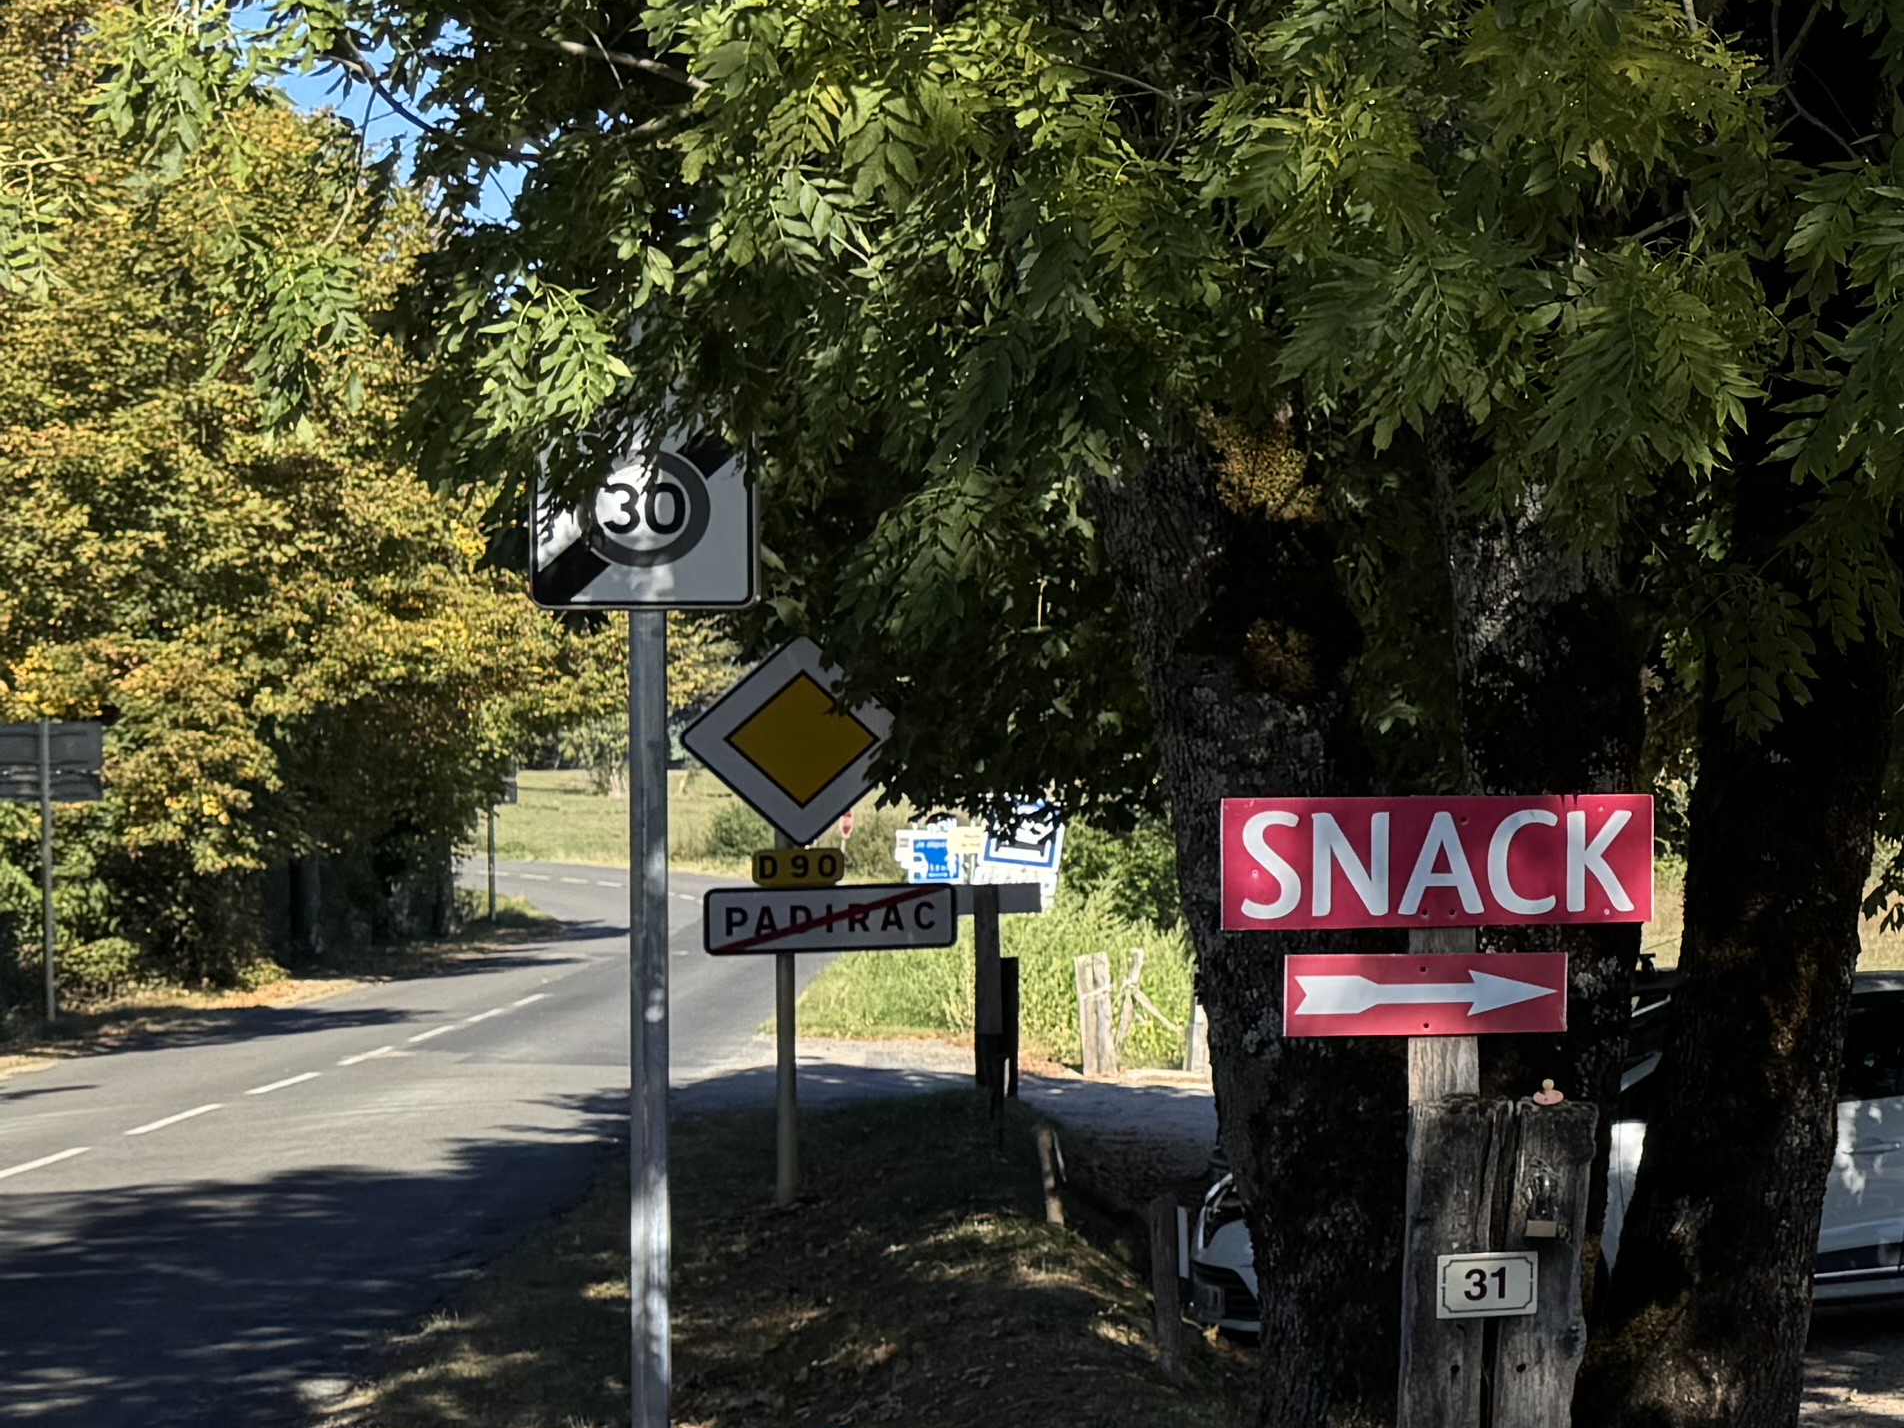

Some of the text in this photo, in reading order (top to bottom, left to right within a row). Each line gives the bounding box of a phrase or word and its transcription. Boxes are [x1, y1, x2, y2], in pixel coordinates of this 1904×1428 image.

[602, 482, 686, 535] 30
[759, 853, 838, 880] D 90
[1240, 807, 1635, 920] SNACK
[724, 900, 936, 937] PADIRAC
[1462, 1267, 1510, 1302] 31
